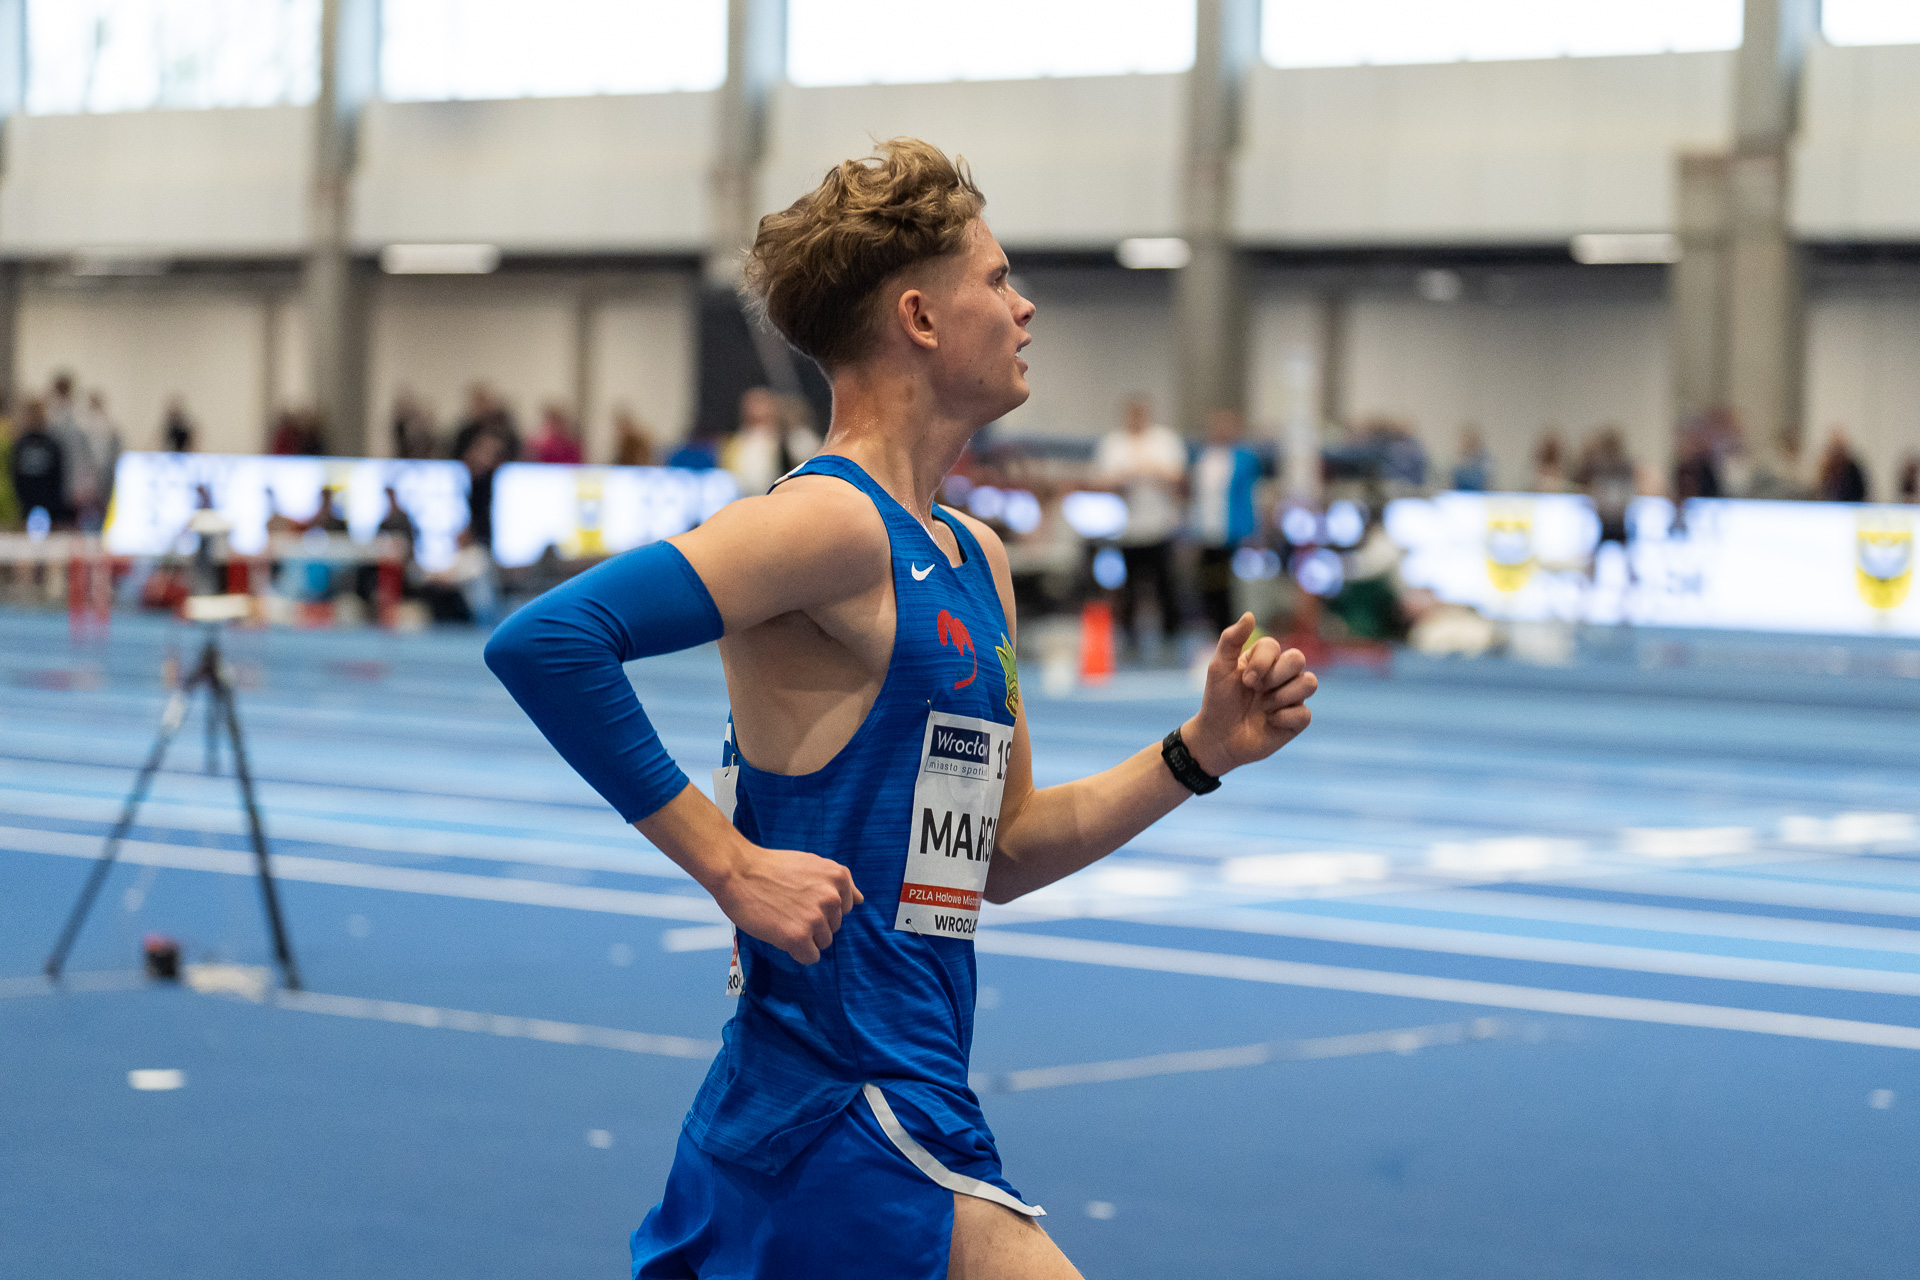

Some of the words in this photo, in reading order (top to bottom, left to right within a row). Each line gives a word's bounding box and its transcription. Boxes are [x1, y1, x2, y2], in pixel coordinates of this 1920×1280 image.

[928, 760, 958, 772] miasto
[908, 888, 934, 902] PZLA
[935, 891, 962, 905] Halowe
